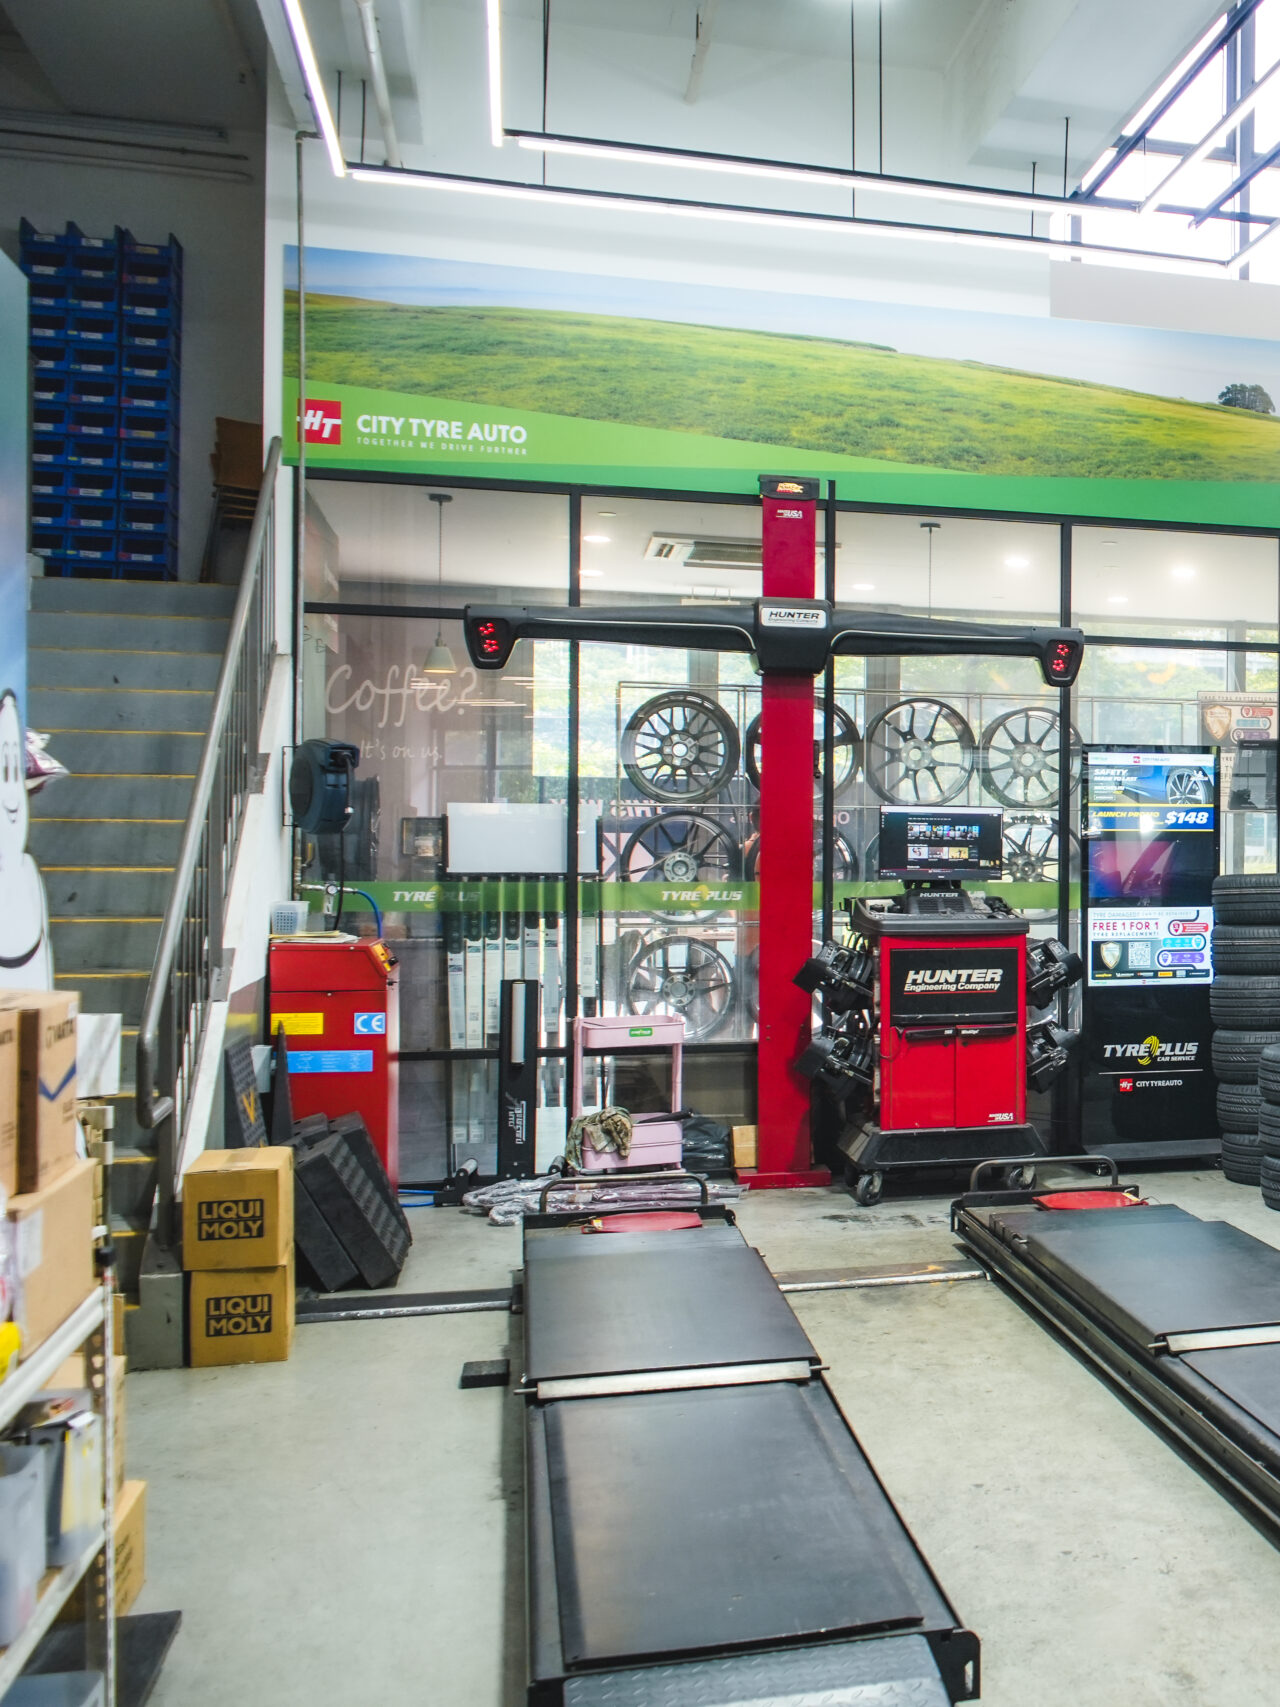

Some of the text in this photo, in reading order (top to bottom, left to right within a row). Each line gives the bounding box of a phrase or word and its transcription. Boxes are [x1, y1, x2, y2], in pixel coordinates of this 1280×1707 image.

[357, 414, 528, 444] CITY TYRE AUTO
[357, 437, 413, 448] TOGETHER
[441, 443, 474, 452] DRIVE
[480, 446, 528, 456] FURTHER
[769, 611, 819, 619] HUNTER
[325, 663, 478, 729] Coffee?
[360, 738, 386, 760] It's
[392, 746, 415, 759] on
[1165, 811, 1209, 825] $148
[392, 891, 436, 902] TYRE
[661, 891, 742, 902] TYRE PLUS
[1093, 921, 1159, 931] FREE 1 FOR 1
[906, 968, 1004, 984] HUNTER
[904, 982, 1001, 993] Engineering Company
[356, 1014, 384, 1033] CE
[1103, 1042, 1200, 1057] TYRE PLUS
[201, 1200, 261, 1220] LIQUI
[201, 1220, 262, 1240] MOLY
[209, 1296, 269, 1316] LIQUI
[209, 1316, 270, 1336] MOLY
